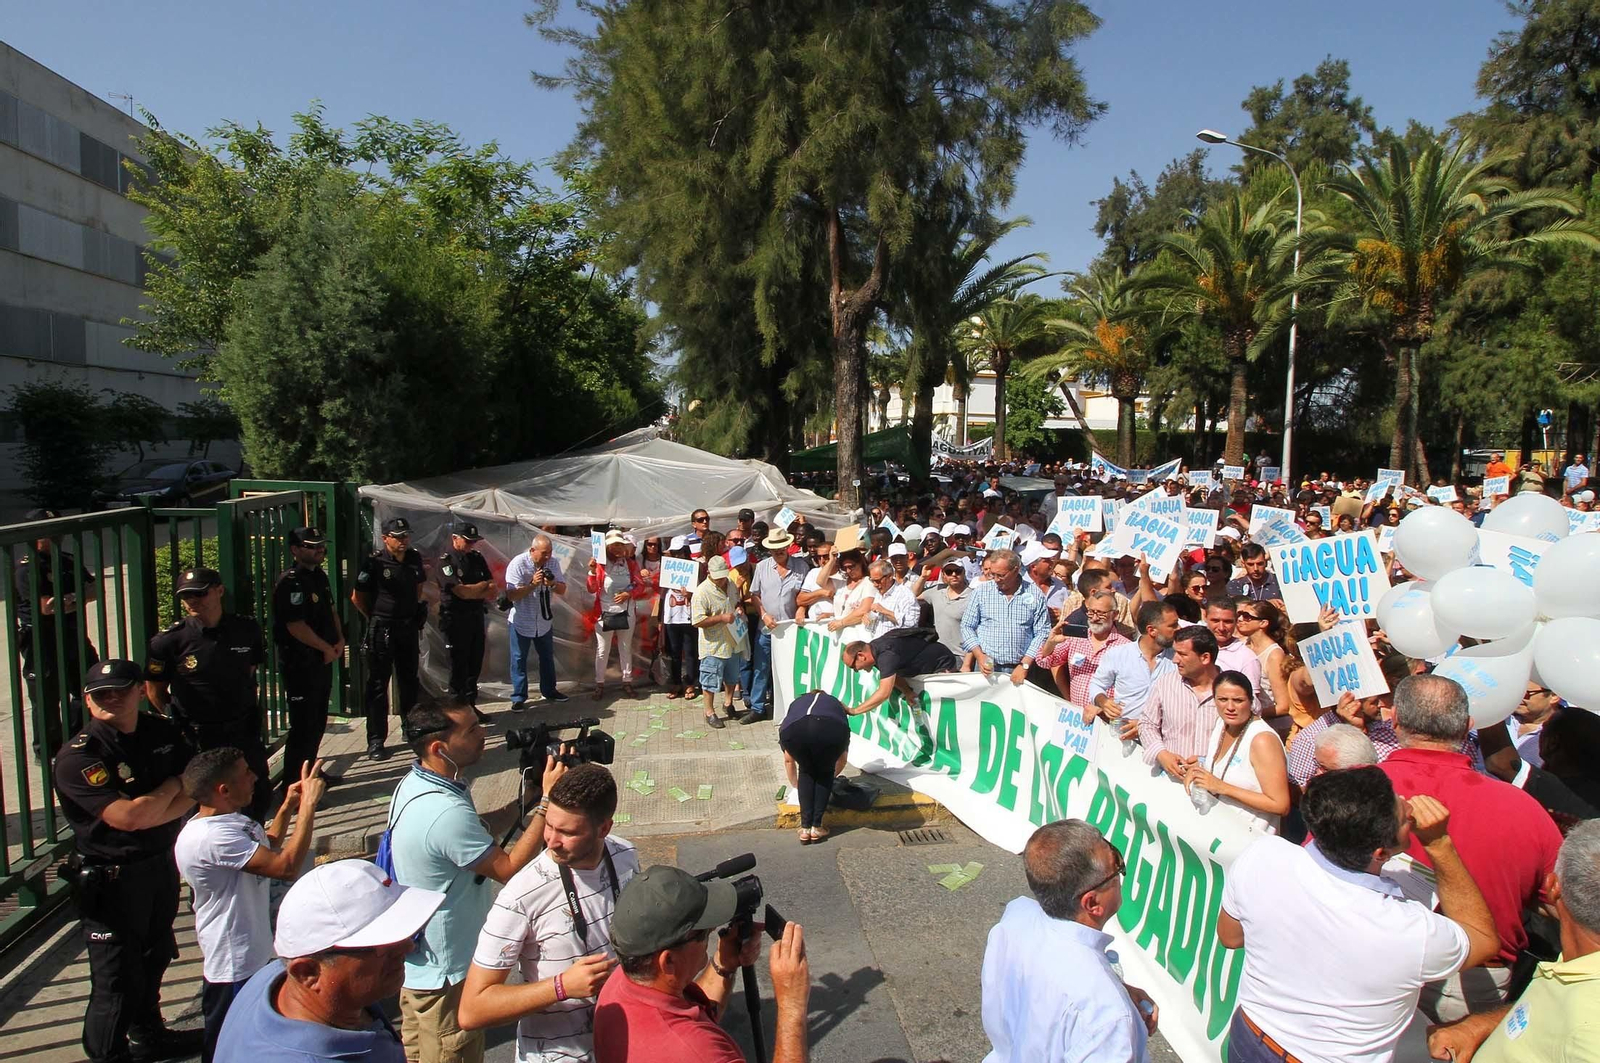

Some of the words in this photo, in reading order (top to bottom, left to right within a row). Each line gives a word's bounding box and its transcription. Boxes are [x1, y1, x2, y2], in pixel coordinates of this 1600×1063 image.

[1061, 499, 1096, 512] ¡¡AGUA
[1151, 500, 1182, 514] ¡¡AGUA
[1069, 514, 1092, 527] YA!!
[1125, 511, 1179, 544] ¡¡AGUA
[1270, 519, 1305, 544] ¡¡AGU
[1130, 533, 1167, 560] YA!!
[664, 560, 695, 573] ¡¡AGUA
[1280, 535, 1378, 585] ¡¡AGUA
[670, 574, 690, 587] YA!!
[1312, 576, 1371, 616] YA!!
[1306, 631, 1359, 669] ¡¡AGUA
[1324, 662, 1360, 695] YA!!
[1064, 729, 1089, 755] YA!!
[969, 701, 1026, 812] DE
[1085, 768, 1246, 1063] REGADÍO
[569, 891, 580, 914] Canon
[91, 932, 113, 940] CNP
